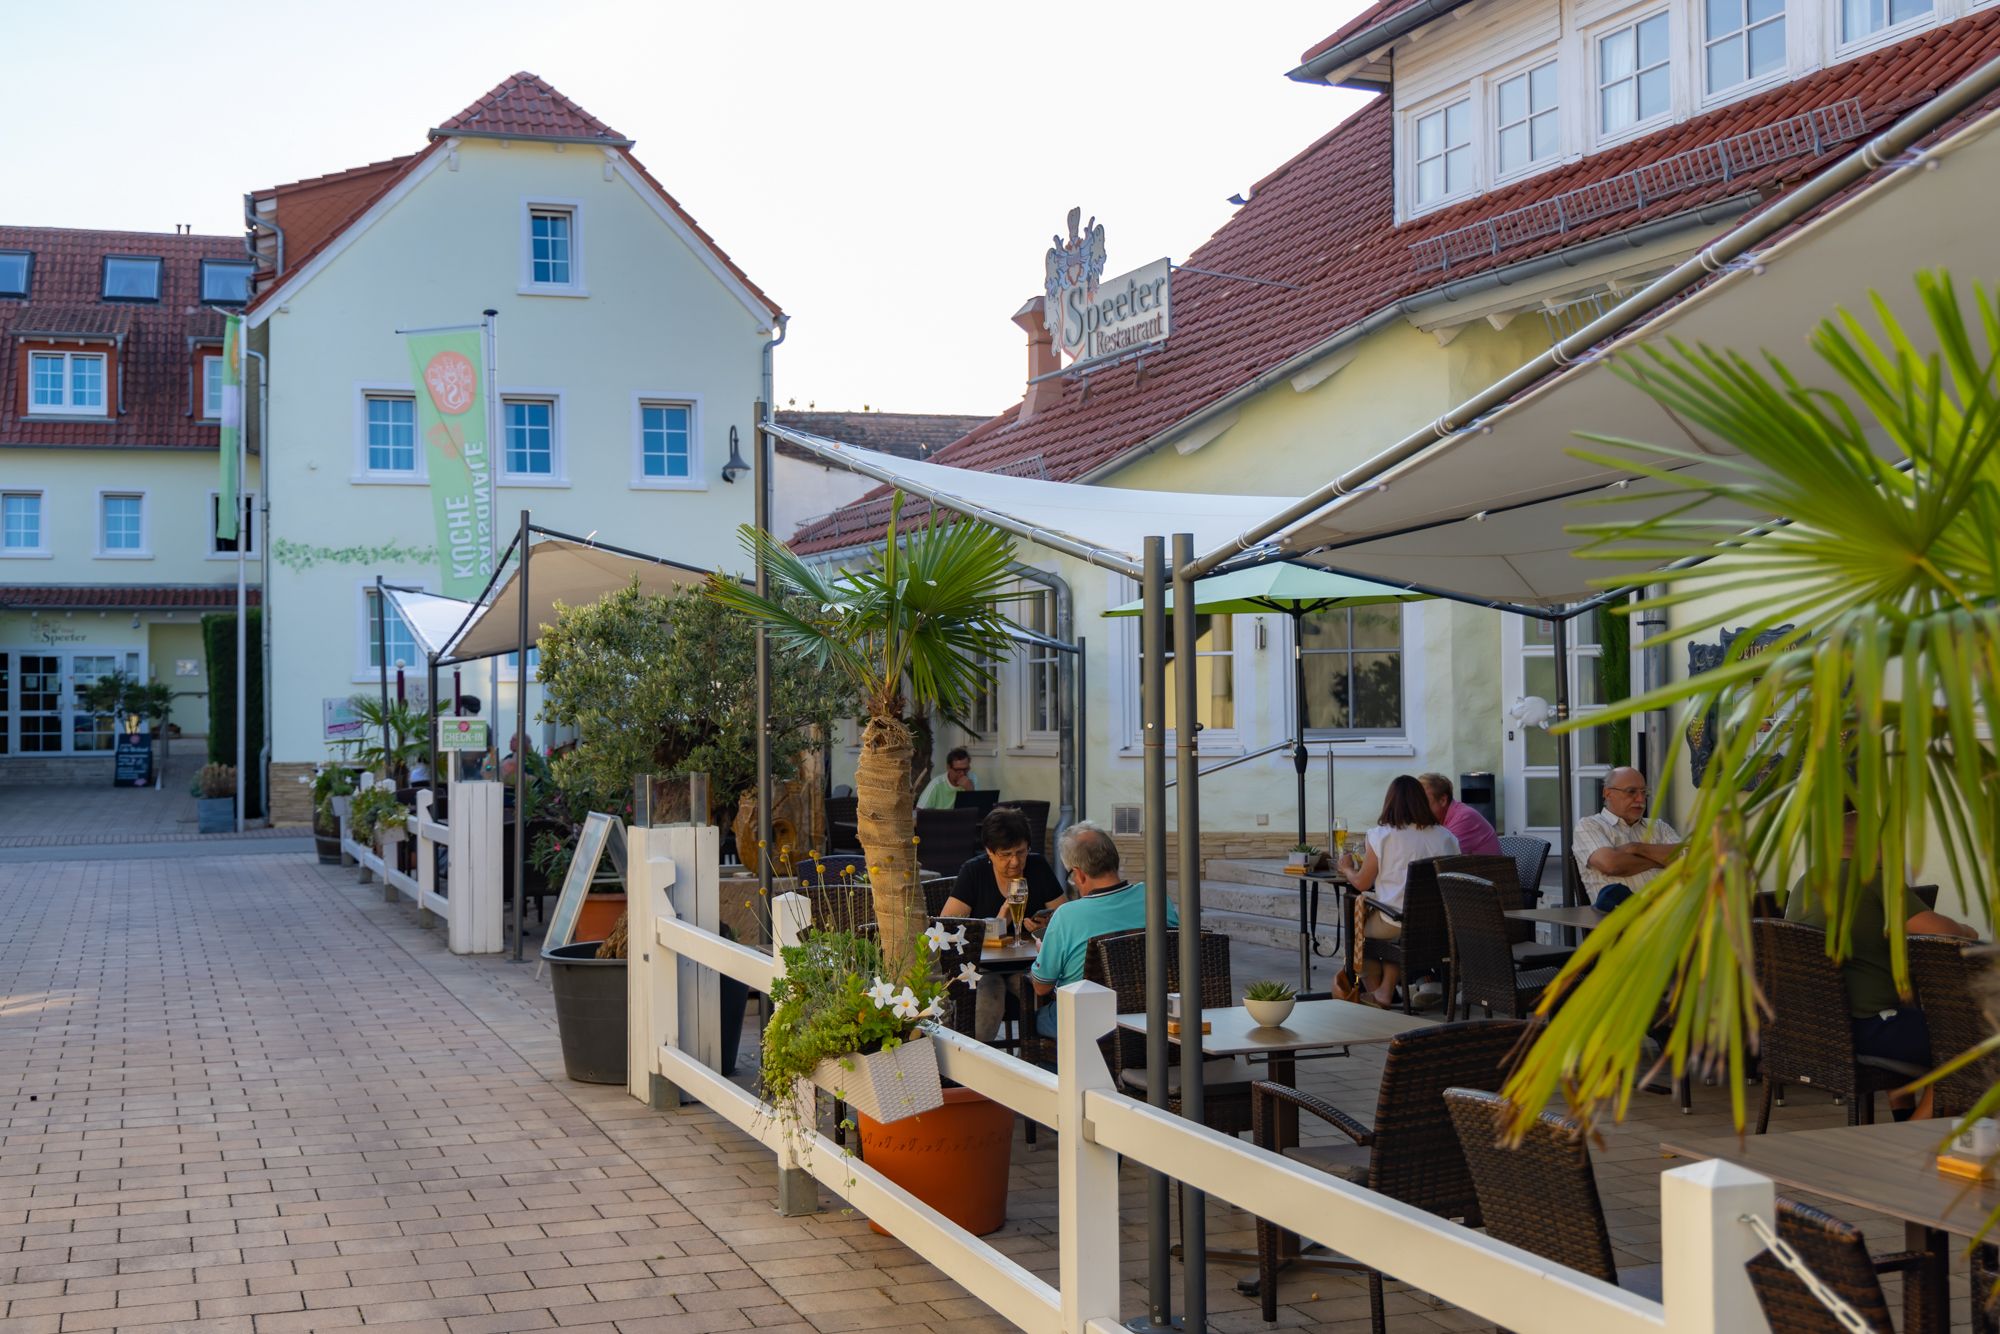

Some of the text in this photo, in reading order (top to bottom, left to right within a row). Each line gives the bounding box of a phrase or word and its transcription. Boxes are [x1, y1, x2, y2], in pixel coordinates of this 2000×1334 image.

[1064, 276, 1166, 362] Speeter
[1096, 311, 1163, 356] Restaurant
[443, 732, 484, 743] CHECK-IN
